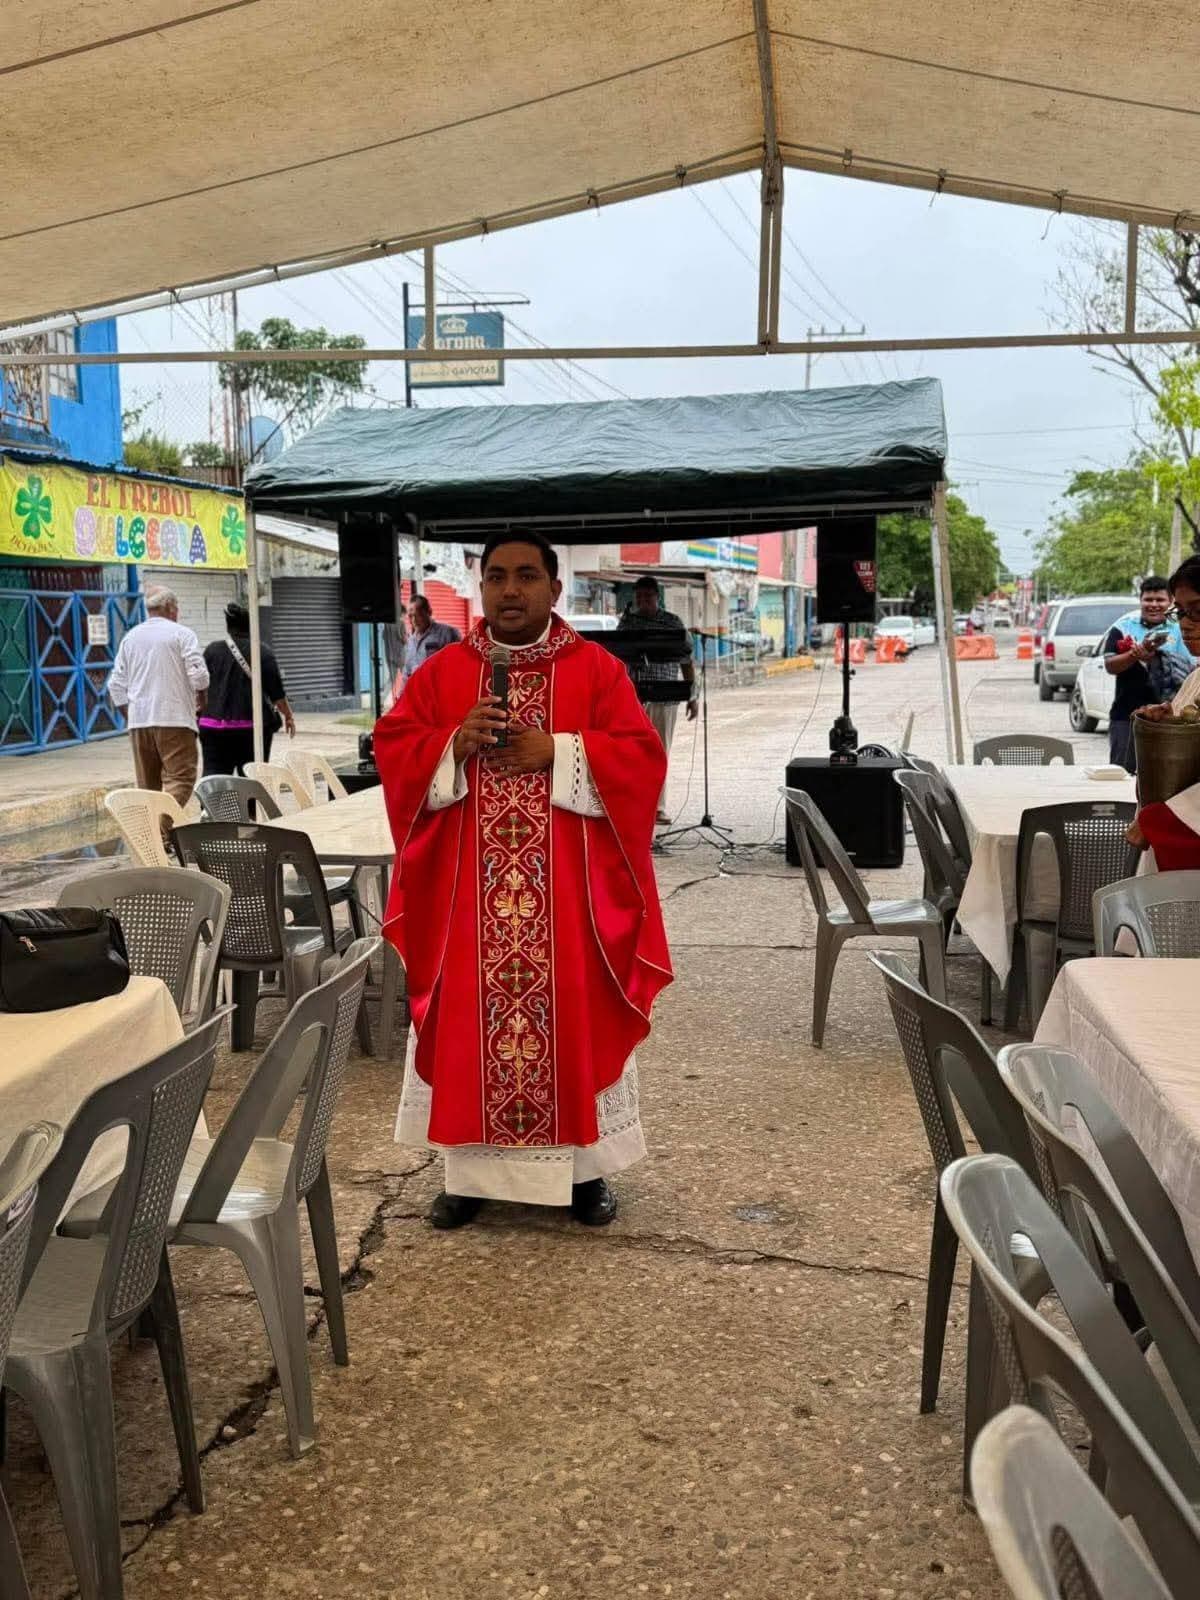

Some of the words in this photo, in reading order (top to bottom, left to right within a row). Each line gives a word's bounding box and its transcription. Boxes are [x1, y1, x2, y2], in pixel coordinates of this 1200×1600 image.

[87, 475, 111, 508] EL
[119, 479, 197, 519] TREBOL
[74, 507, 208, 565] DULCERIA
